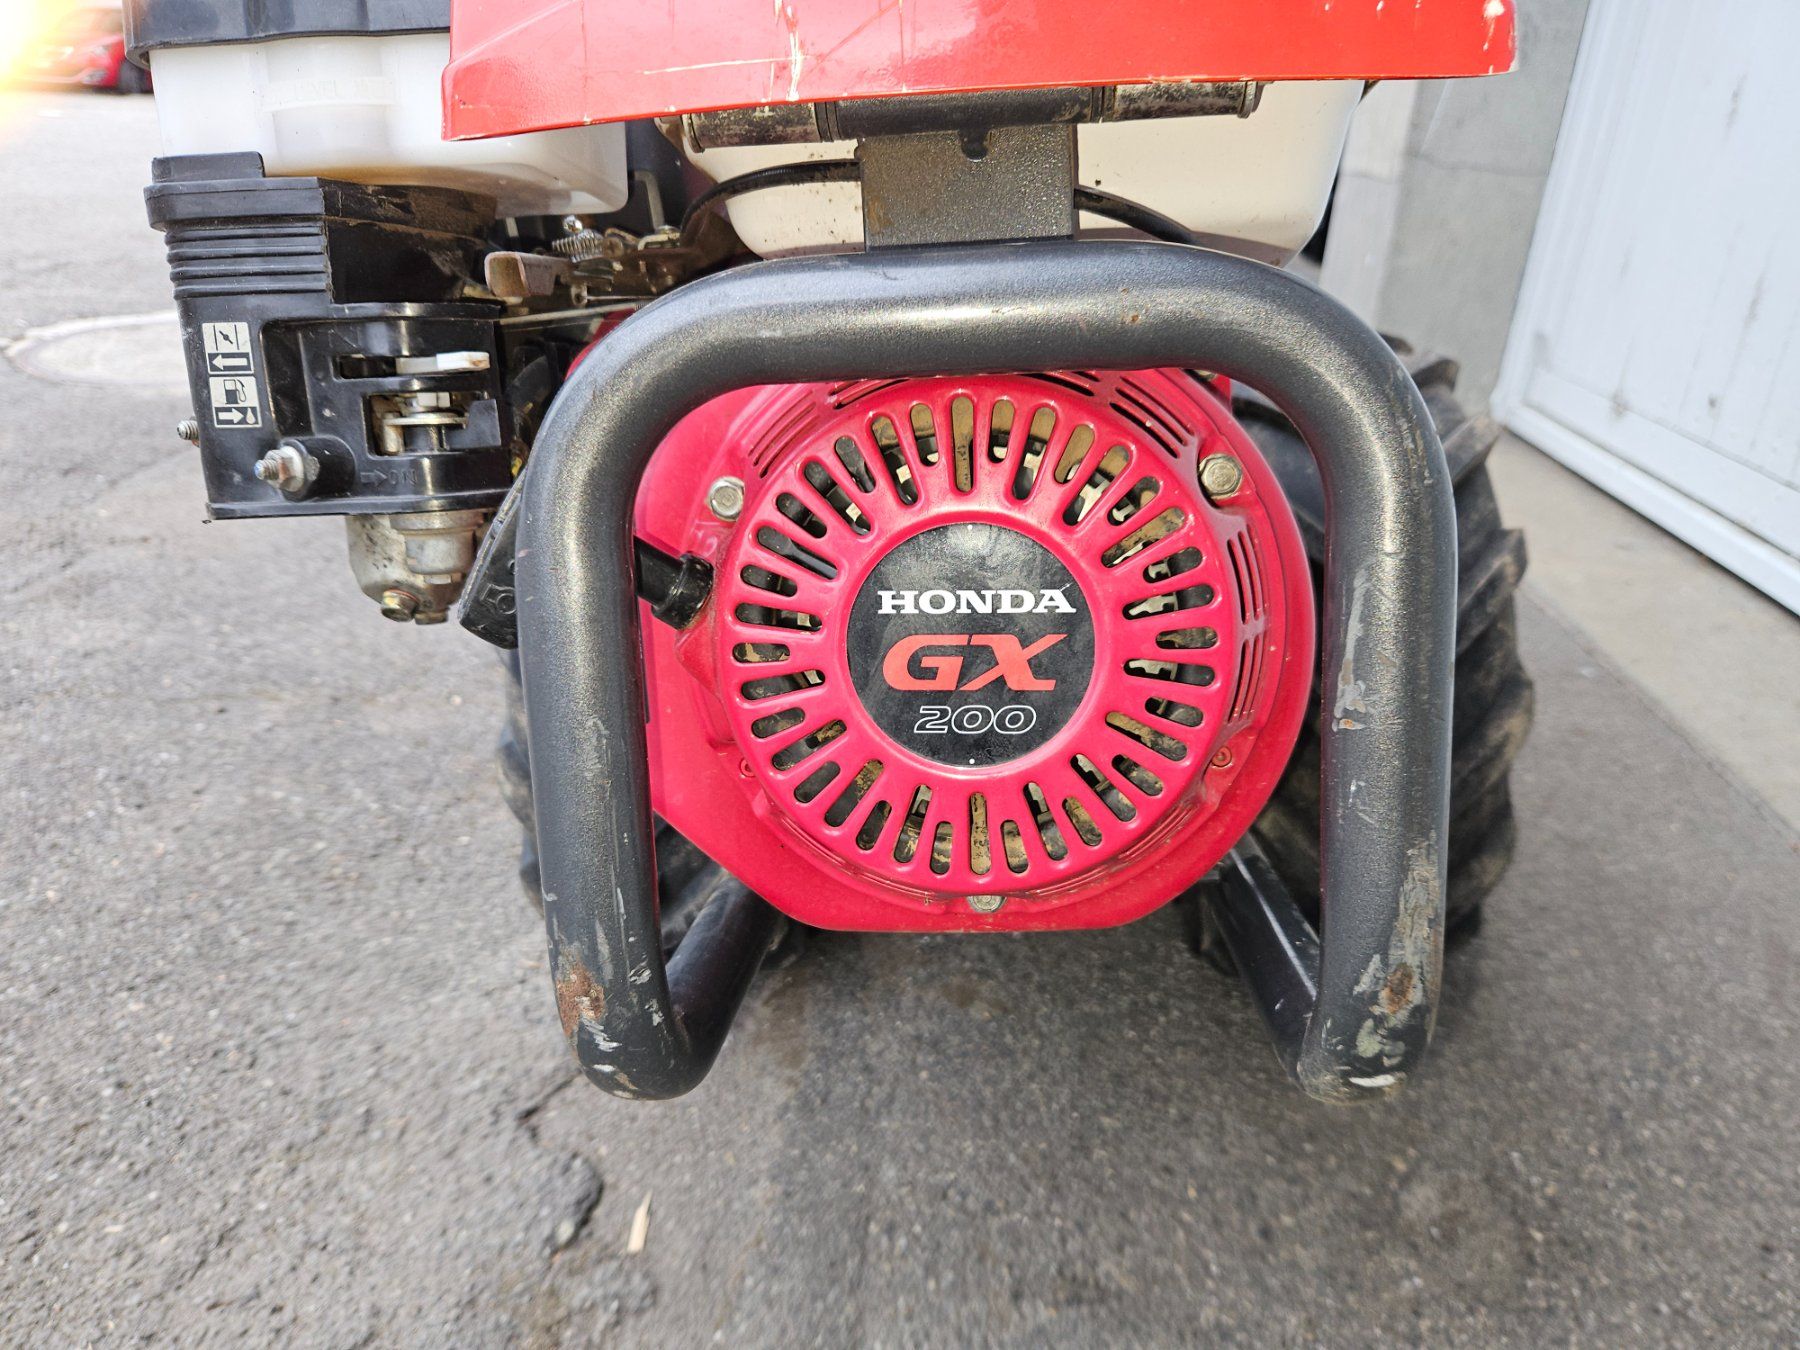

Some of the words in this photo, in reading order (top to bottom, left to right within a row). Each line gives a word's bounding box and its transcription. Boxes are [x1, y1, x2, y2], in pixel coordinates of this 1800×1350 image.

[877, 589, 1076, 614] HONDA
[882, 633, 1069, 691] GX
[913, 704, 1037, 734] 200
